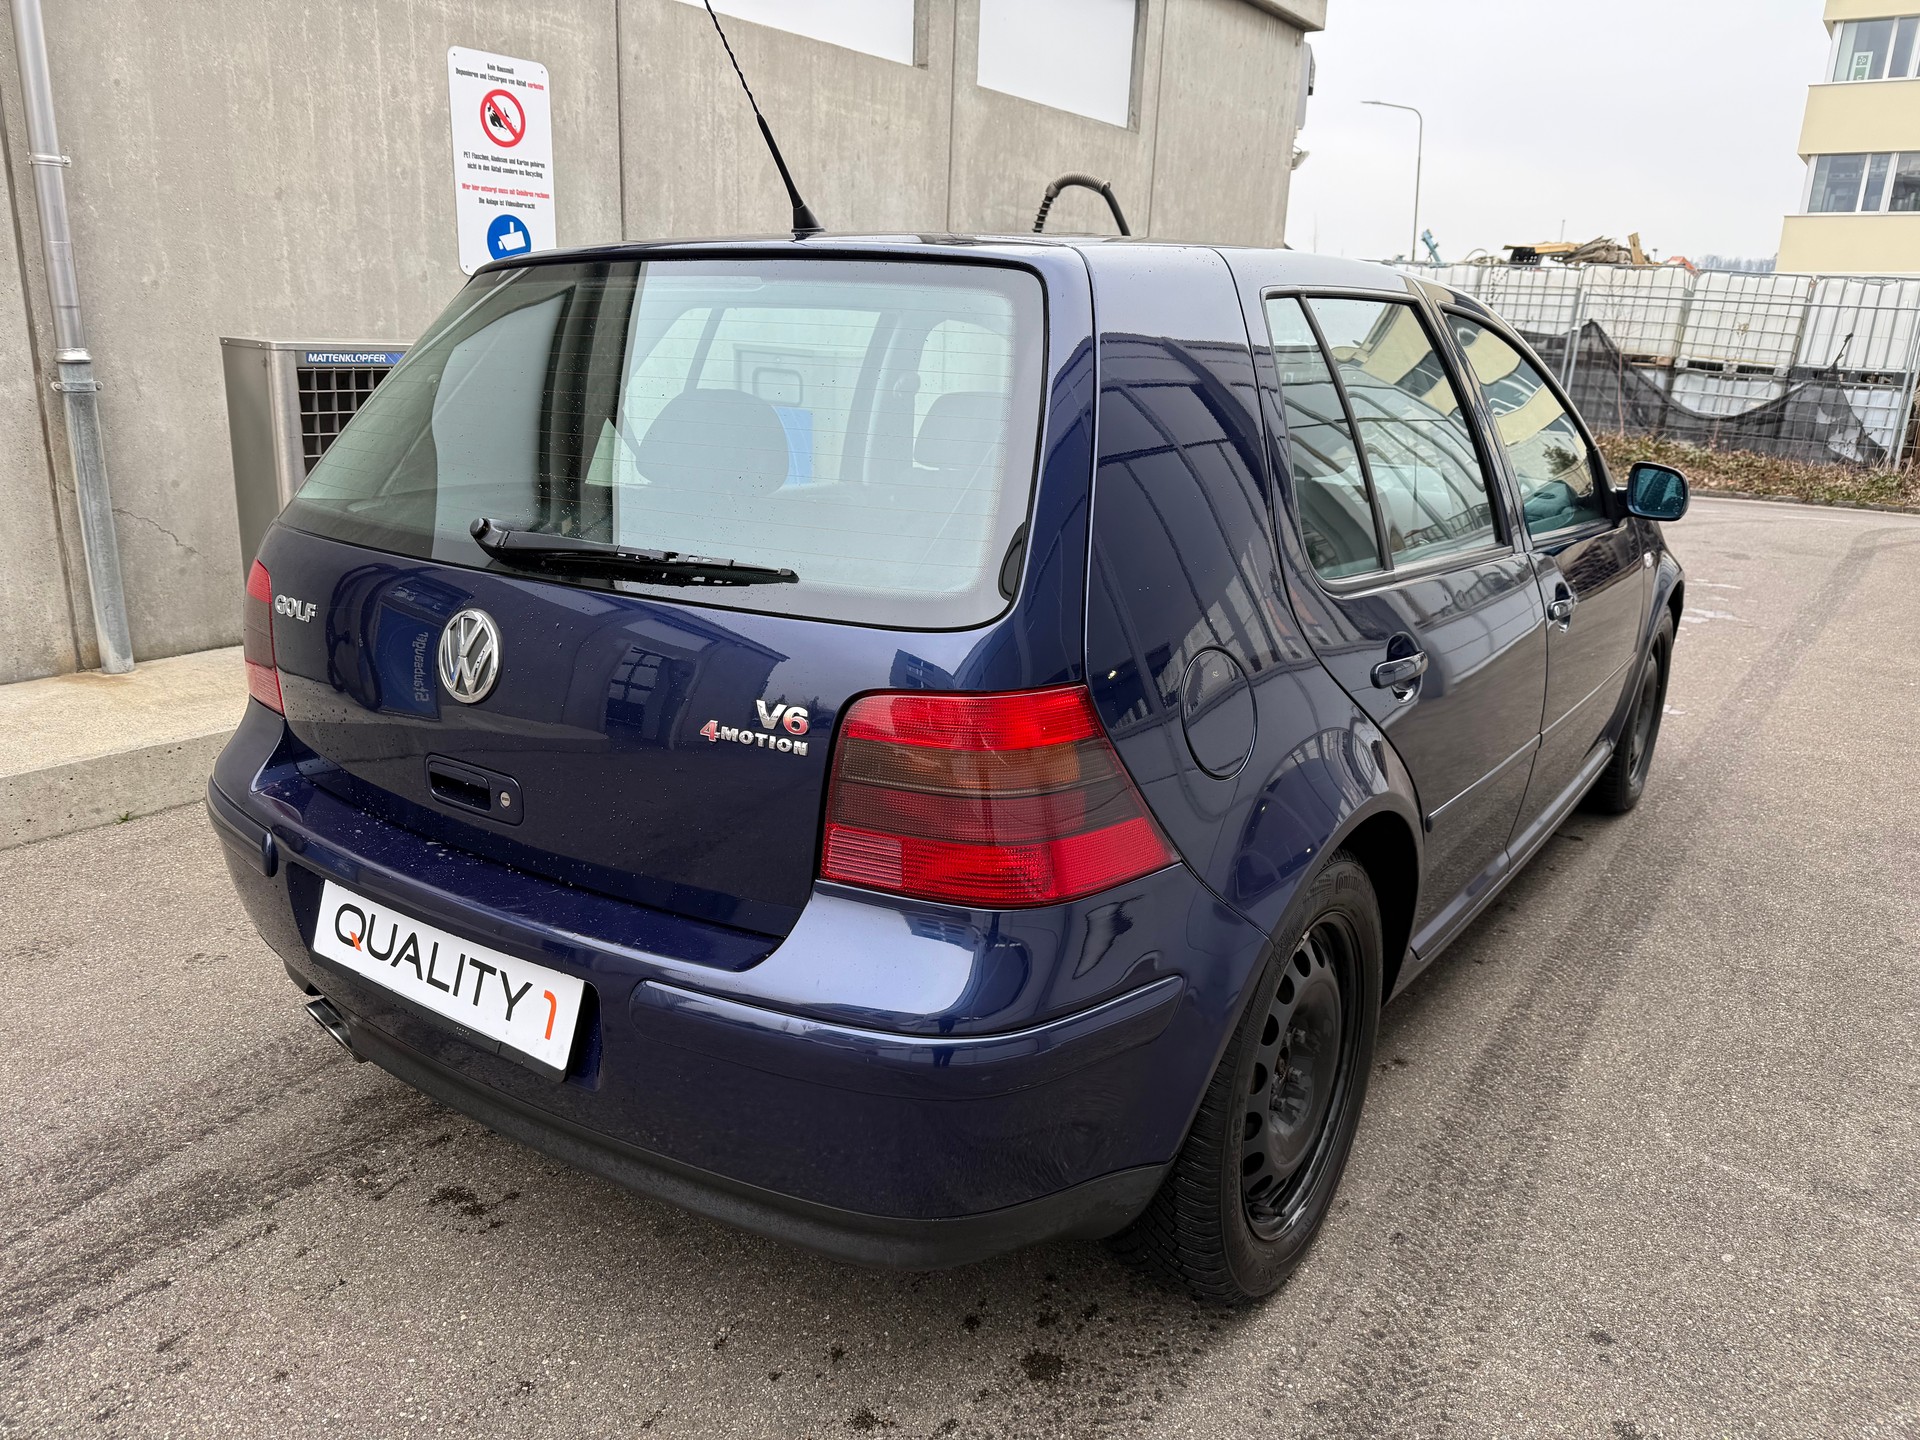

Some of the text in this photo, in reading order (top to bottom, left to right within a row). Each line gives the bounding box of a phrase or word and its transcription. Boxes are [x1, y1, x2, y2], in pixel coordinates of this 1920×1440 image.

[456, 67, 478, 78] Deponieren
[488, 73, 507, 84] Entsorgen
[527, 82, 544, 90] verboten
[471, 152, 490, 162] Flaschen,
[502, 167, 518, 175] sondern
[525, 169, 543, 179] Recycling
[461, 182, 471, 190] Wer
[472, 183, 480, 191] hier
[481, 185, 497, 193] entsorgt
[486, 198, 498, 206] Anlage
[308, 353, 386, 363] MATTENKLOPFER
[275, 594, 317, 622] GOLF
[440, 610, 498, 703] VW
[756, 699, 809, 735] V6
[700, 719, 808, 756] 4MOTION
